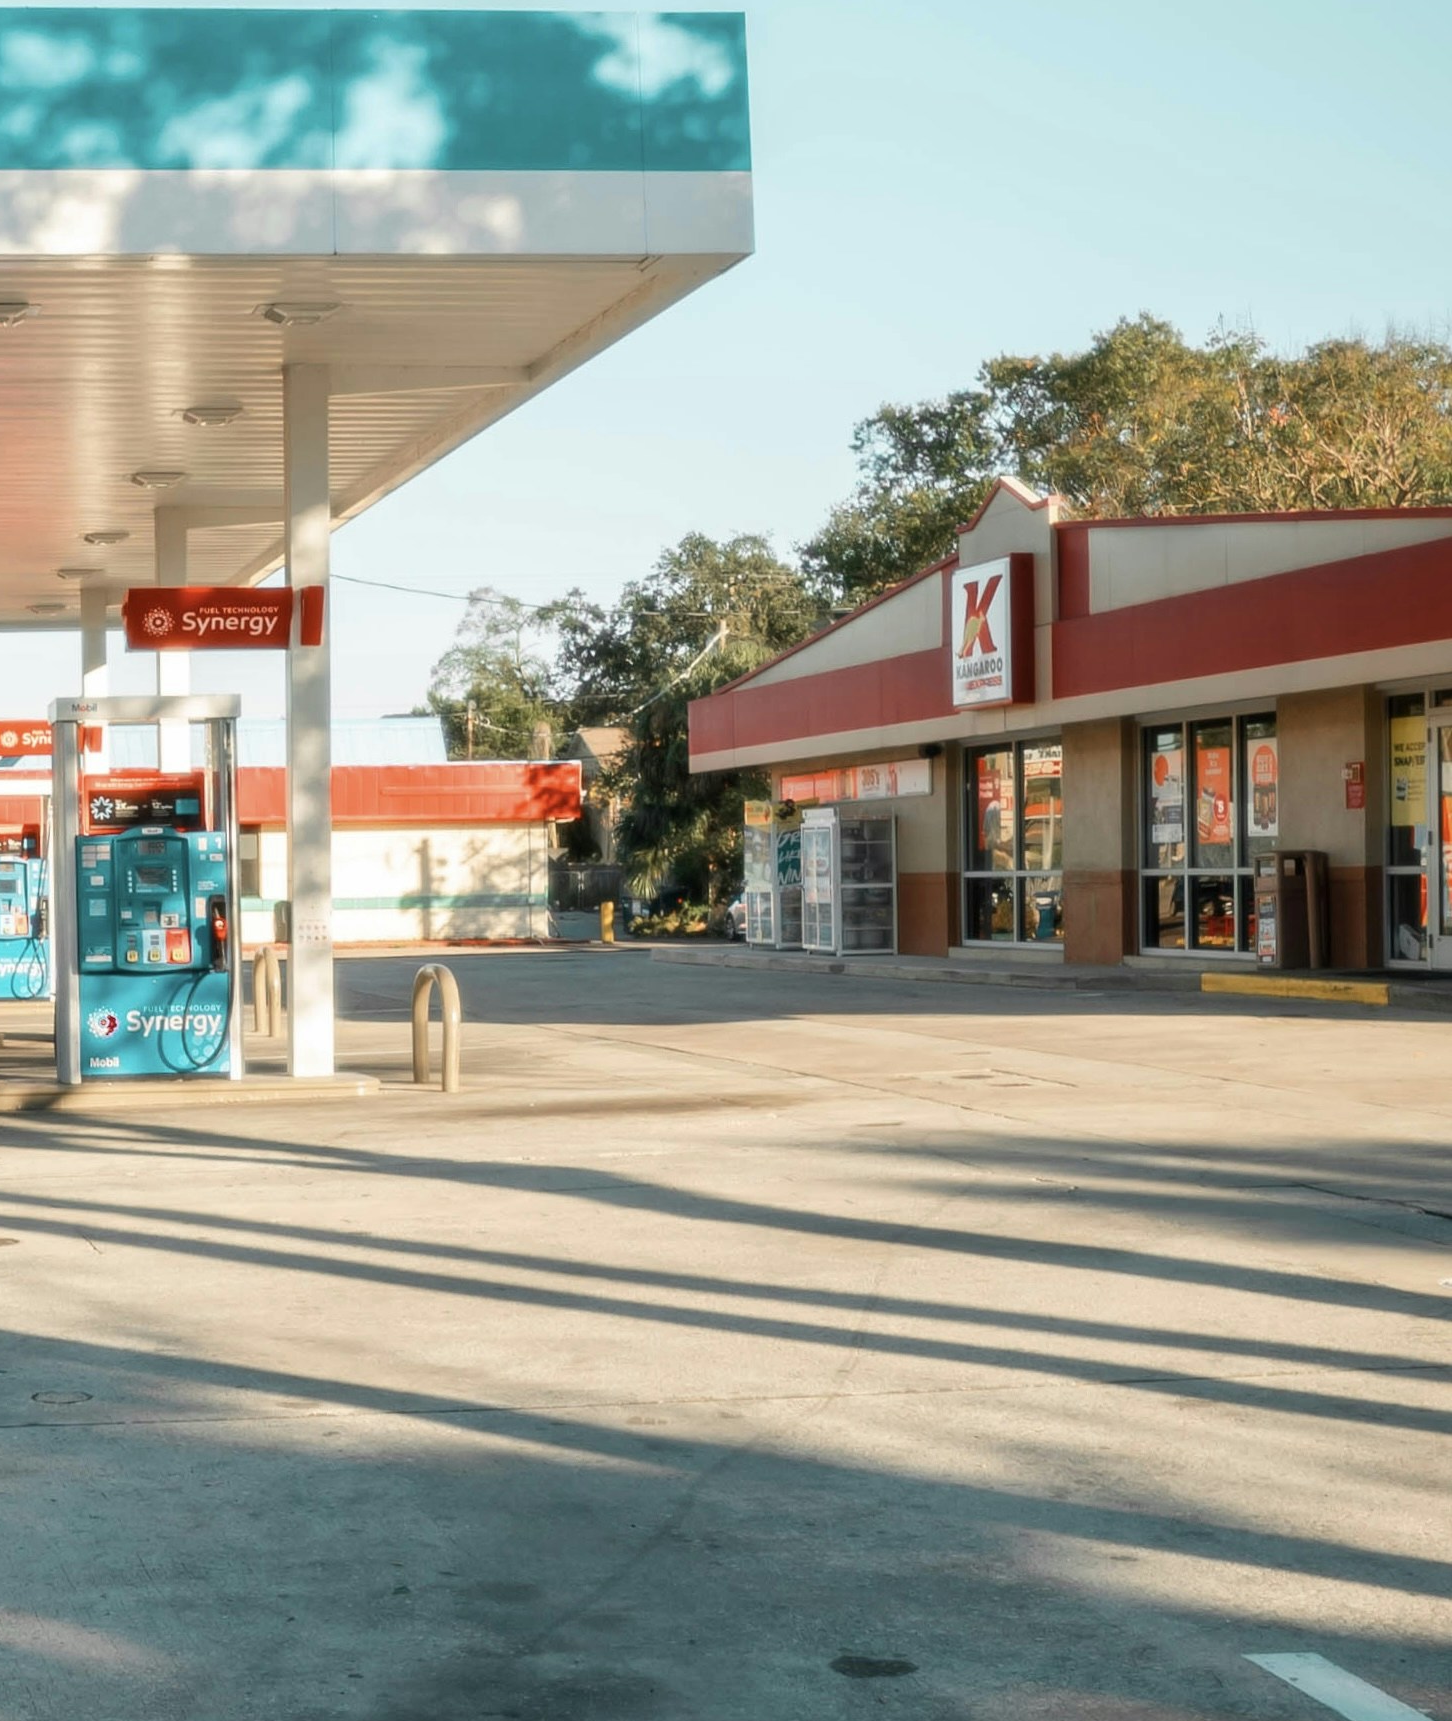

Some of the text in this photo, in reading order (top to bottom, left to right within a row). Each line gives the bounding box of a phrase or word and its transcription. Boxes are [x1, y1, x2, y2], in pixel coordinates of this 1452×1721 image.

[222, 606, 279, 614] TECHNOLOGY
[959, 574, 1003, 659] K
[182, 612, 279, 636] Synergy
[956, 657, 1003, 680] KANGAROO
[71, 703, 97, 712] Mobil
[127, 1010, 221, 1038] Synergy
[89, 1056, 119, 1068] Mobil
